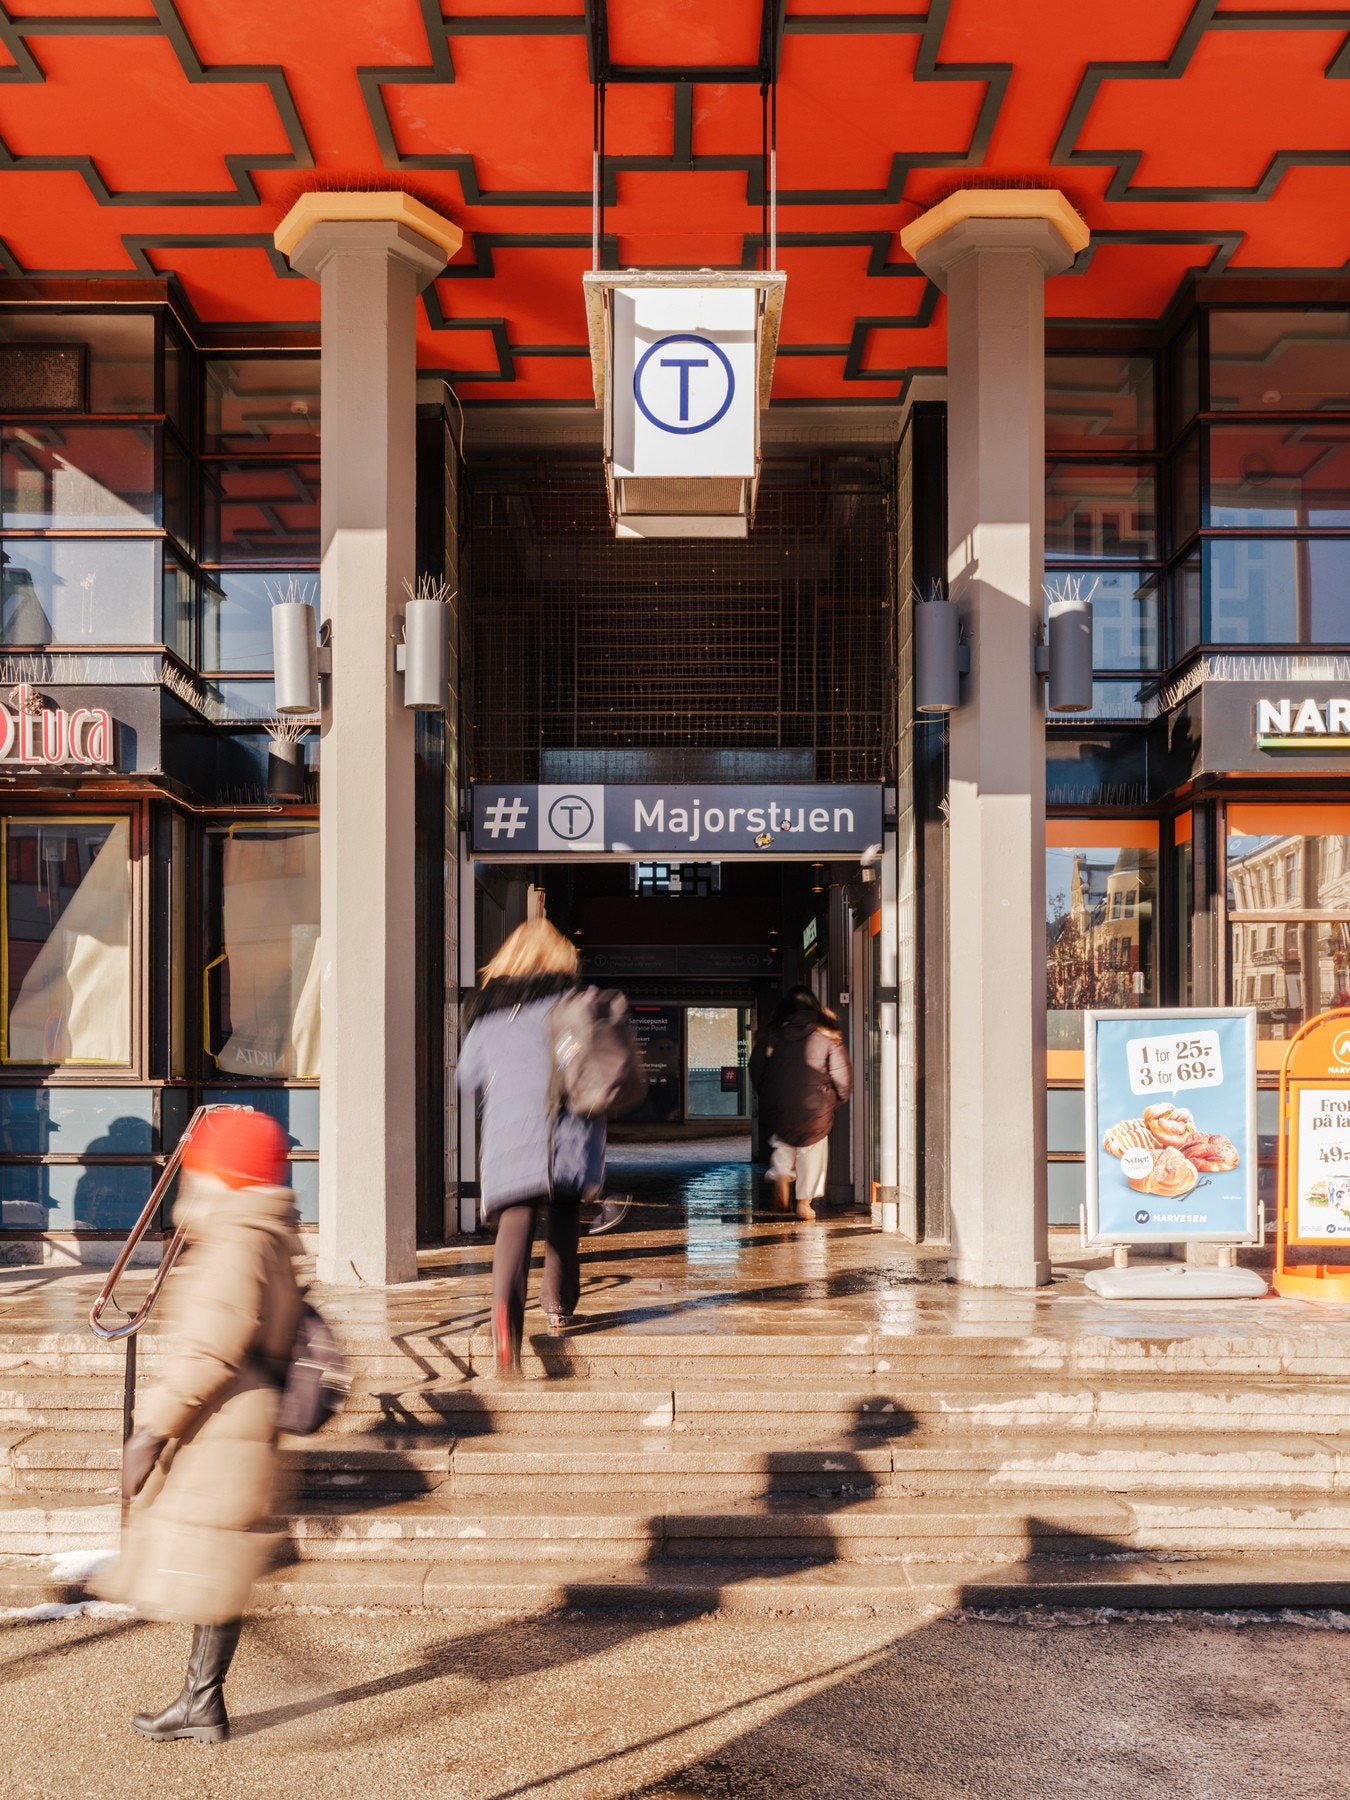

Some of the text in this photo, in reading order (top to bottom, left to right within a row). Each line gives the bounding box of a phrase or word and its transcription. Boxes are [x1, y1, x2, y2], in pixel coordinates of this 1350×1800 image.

[660, 359, 709, 421] T
[560, 806, 582, 834] T
[635, 800, 854, 841] Majorstuen
[1142, 1046, 1149, 1064] 1
[1155, 1049, 1170, 1062] for
[1140, 1068, 1153, 1086] 3
[1158, 1070, 1172, 1084] for
[1312, 1114, 1332, 1130] på
[1153, 1214, 1207, 1223] NARVESEN
